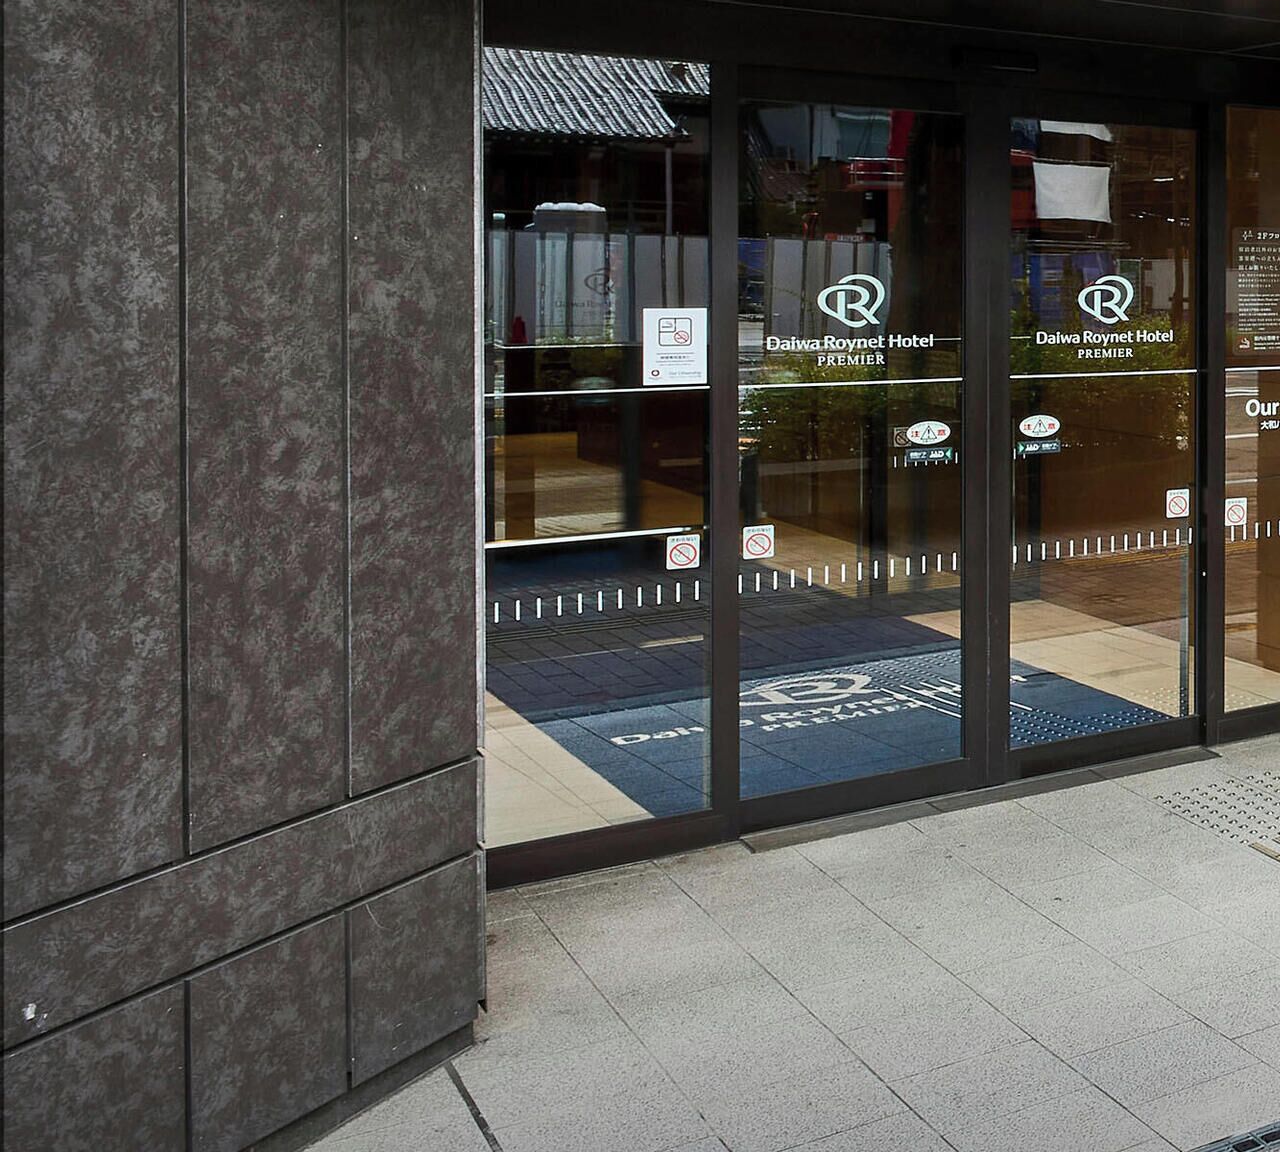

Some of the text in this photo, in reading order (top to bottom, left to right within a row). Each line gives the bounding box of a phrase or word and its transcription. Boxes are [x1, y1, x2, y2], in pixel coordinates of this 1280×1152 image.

[766, 333, 934, 353] Daiwa Roynet Hotel
[1036, 329, 1174, 347] Daiwa Roynet Hotel
[817, 354, 885, 366] PREMIER
[1077, 348, 1134, 359] PREMIER
[1245, 398, 1280, 416] Our
